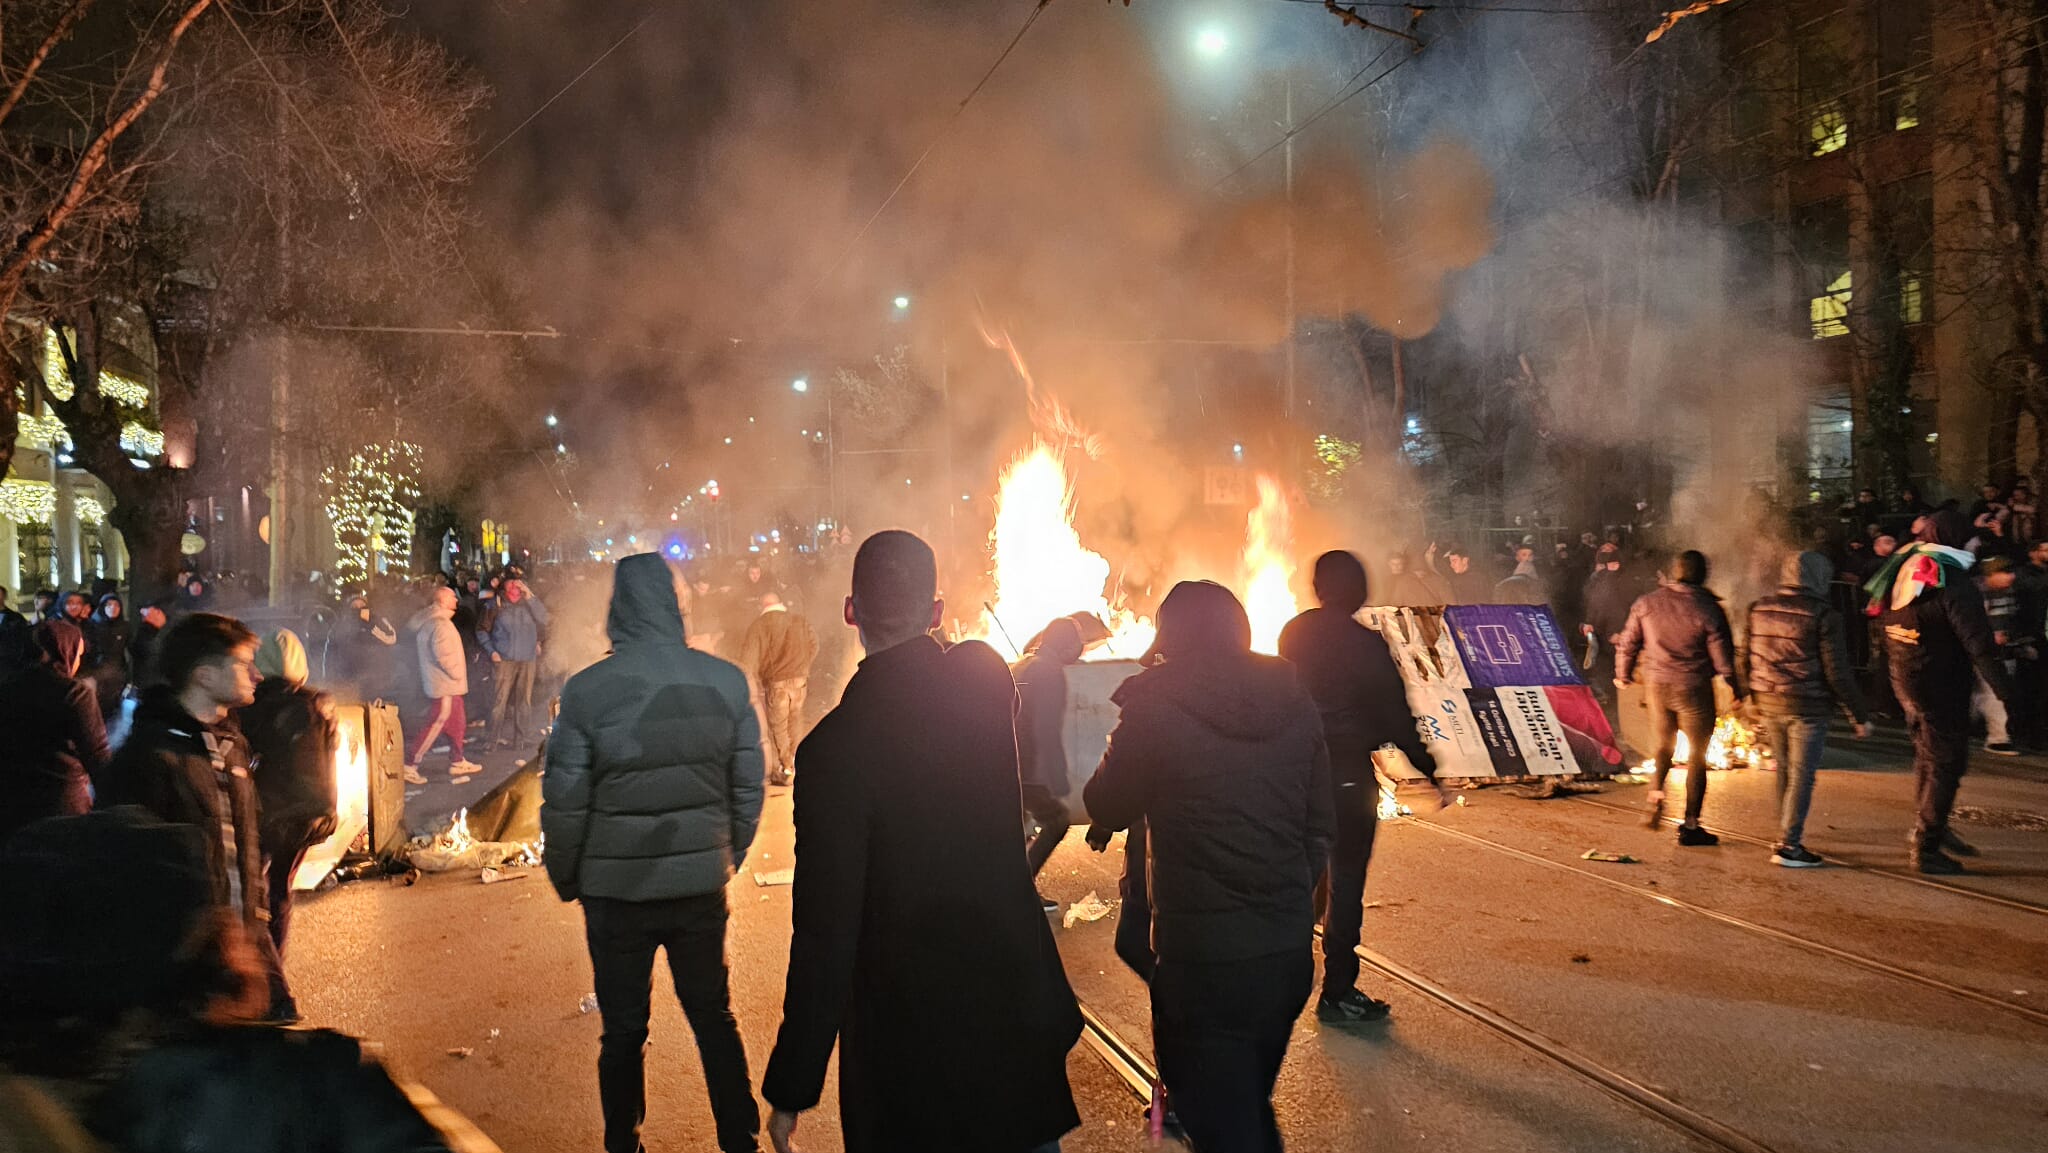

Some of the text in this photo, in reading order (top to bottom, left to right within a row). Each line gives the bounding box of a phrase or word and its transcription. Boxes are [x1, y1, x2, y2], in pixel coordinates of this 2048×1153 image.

[1555, 653, 1574, 676] DAYS
[1491, 708, 1507, 738] October
[1514, 690, 1549, 758] Japanese
[1526, 691, 1562, 760] Bulgarian
